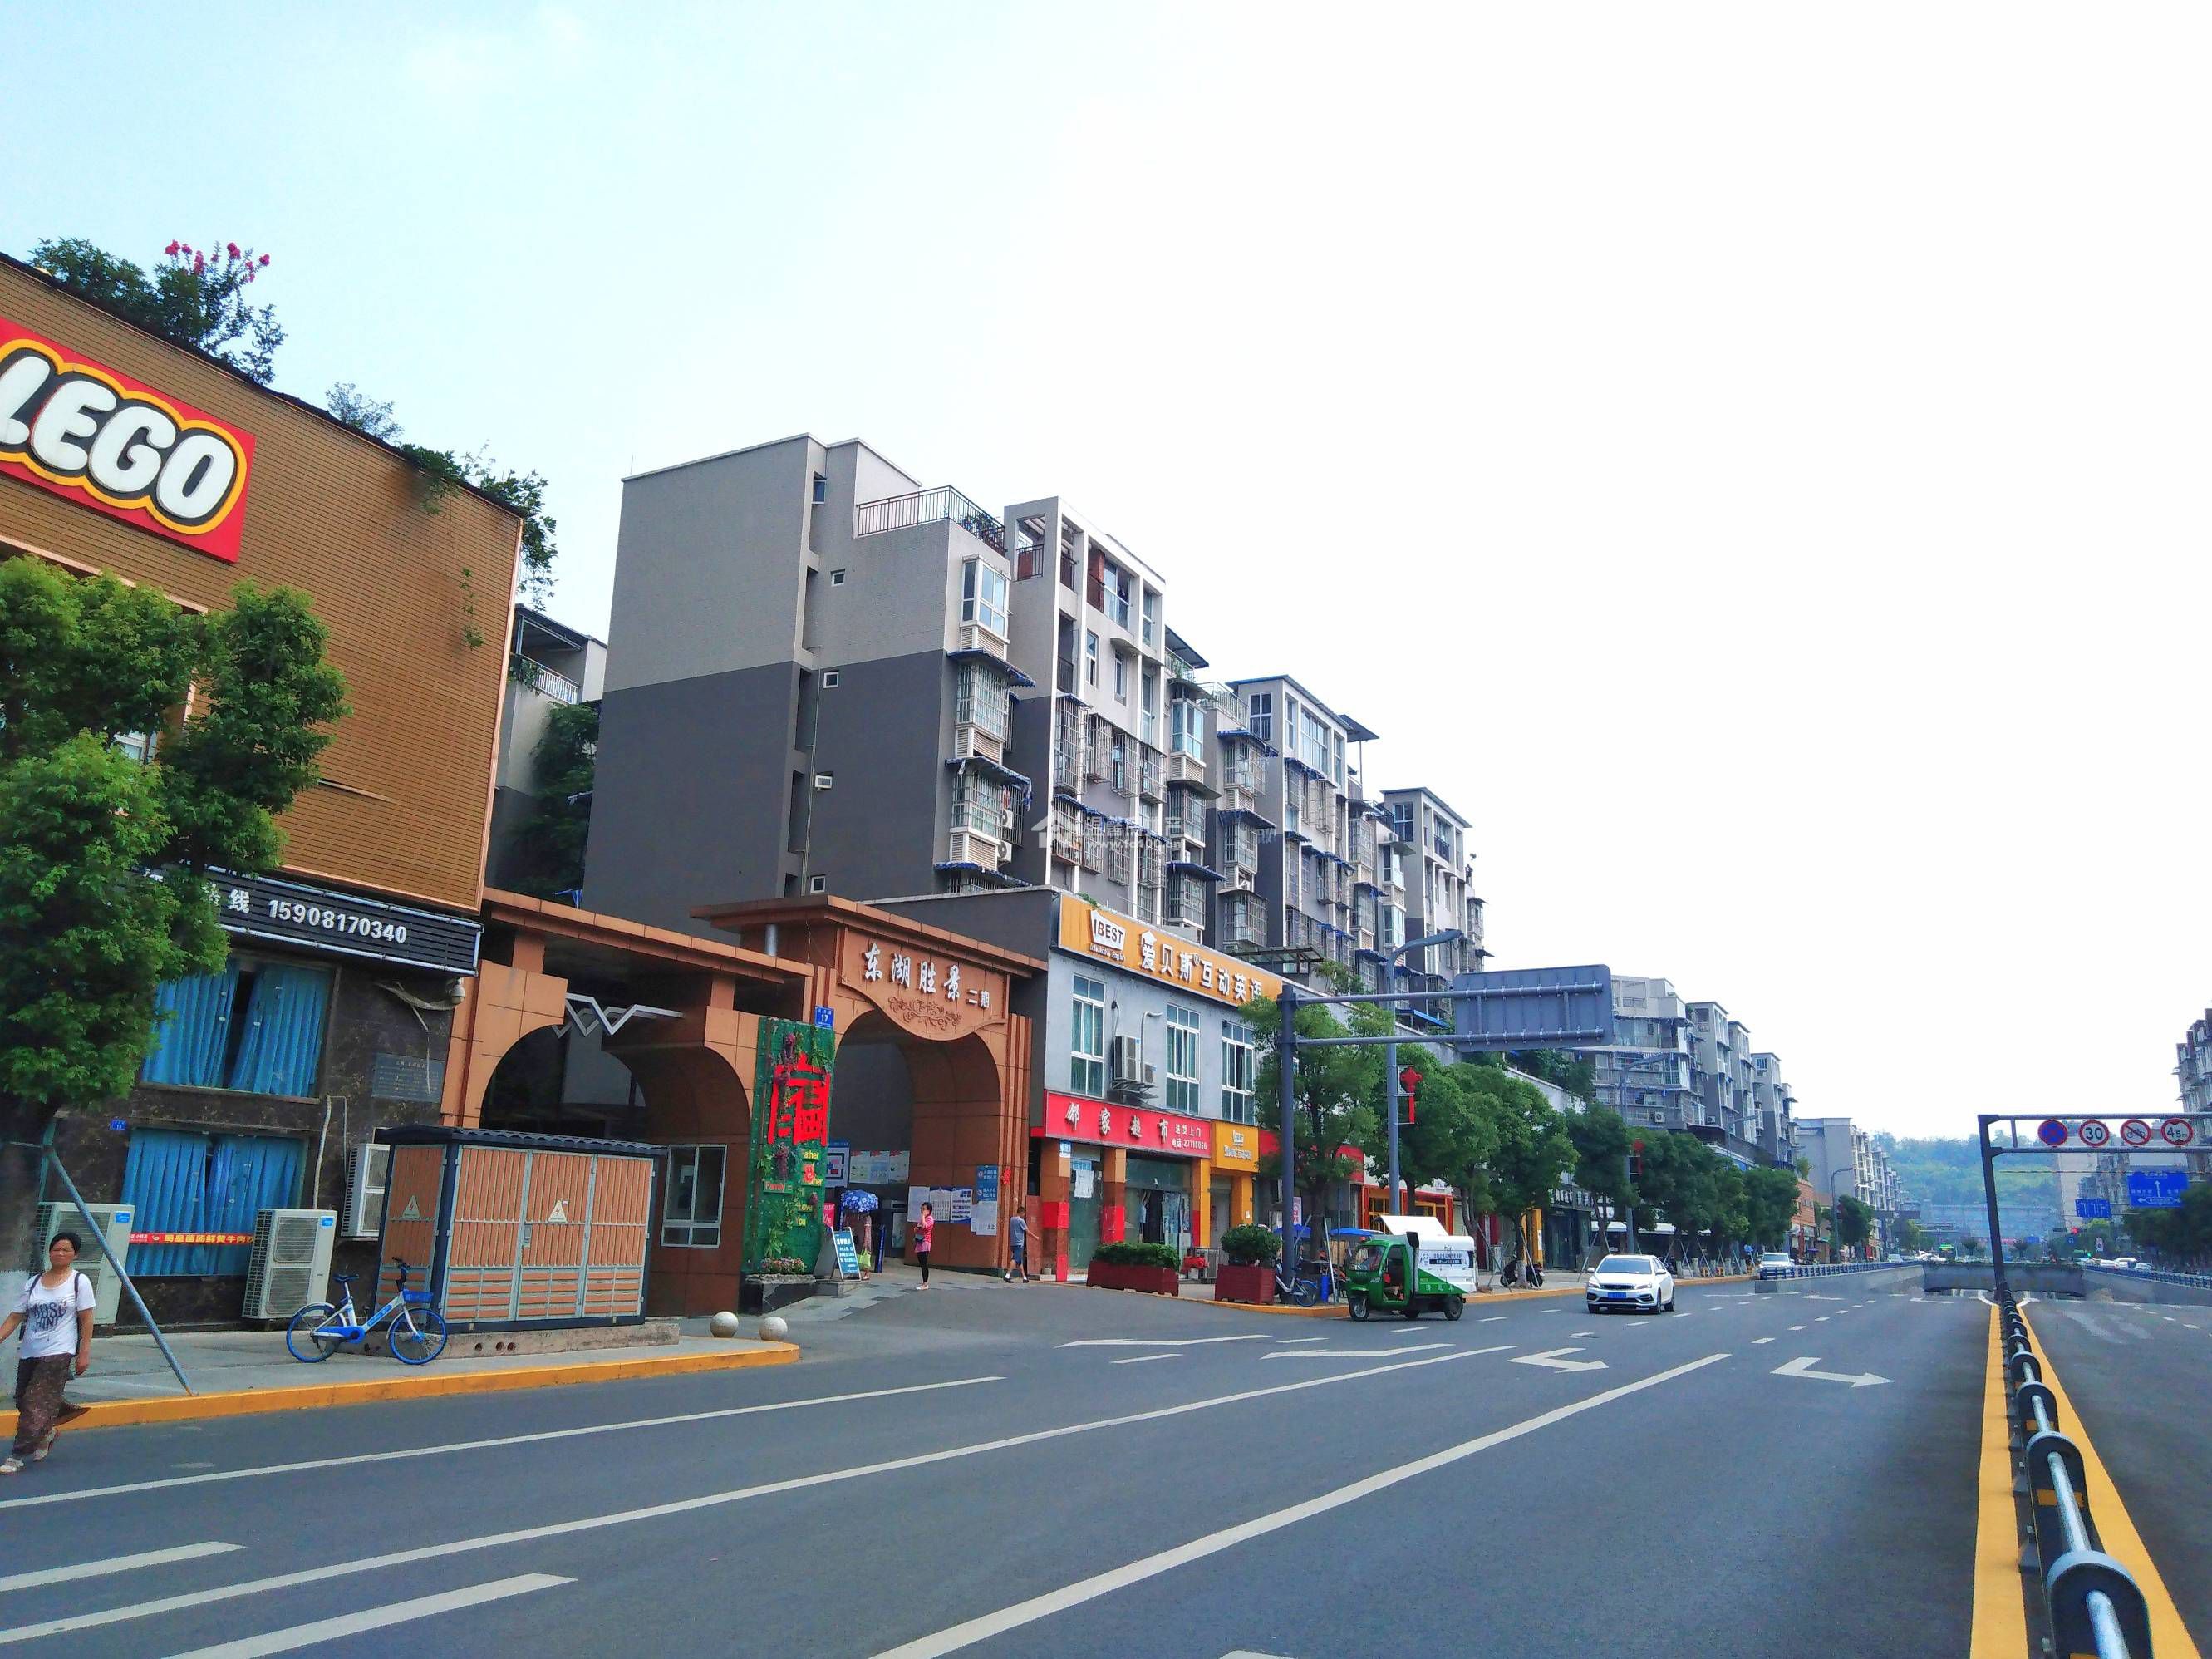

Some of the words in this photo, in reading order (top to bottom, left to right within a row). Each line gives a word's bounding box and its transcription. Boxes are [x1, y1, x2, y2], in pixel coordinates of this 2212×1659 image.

[0, 356, 235, 519] LEGO
[268, 900, 407, 943] 15908170340
[865, 943, 961, 1001] 东湖胜景
[968, 989, 990, 1008] 二期
[821, 1014, 829, 1023] 17
[2085, 1127, 2103, 1140] 30
